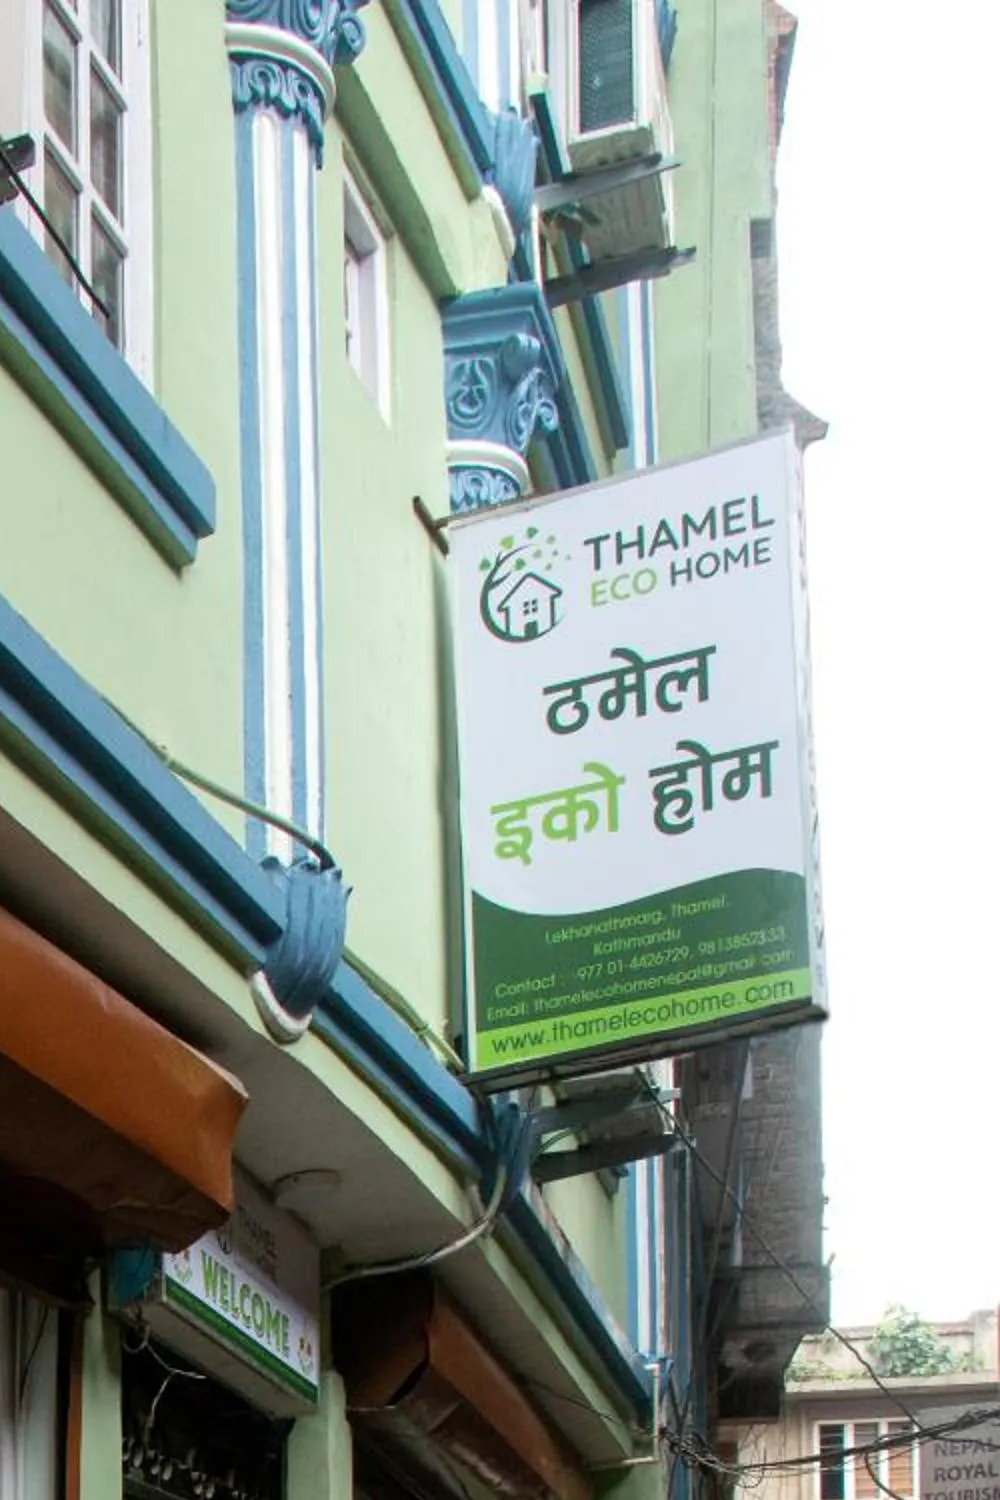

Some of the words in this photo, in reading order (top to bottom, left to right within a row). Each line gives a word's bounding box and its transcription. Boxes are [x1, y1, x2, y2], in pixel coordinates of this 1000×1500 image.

[584, 495, 775, 571] THAMEL
[591, 568, 657, 607] ECO
[670, 537, 771, 586] HOME
[542, 645, 717, 735] ठमेल
[490, 761, 625, 866] इको
[648, 739, 779, 835] होम
[593, 927, 681, 956] Kathmandu
[491, 979, 793, 1053] www.thamelecohome.com
[495, 974, 555, 997] Contact
[201, 1250, 290, 1358] WELCOME
[934, 1437, 996, 1457] NEPAL
[934, 1461, 998, 1482] ROYAL
